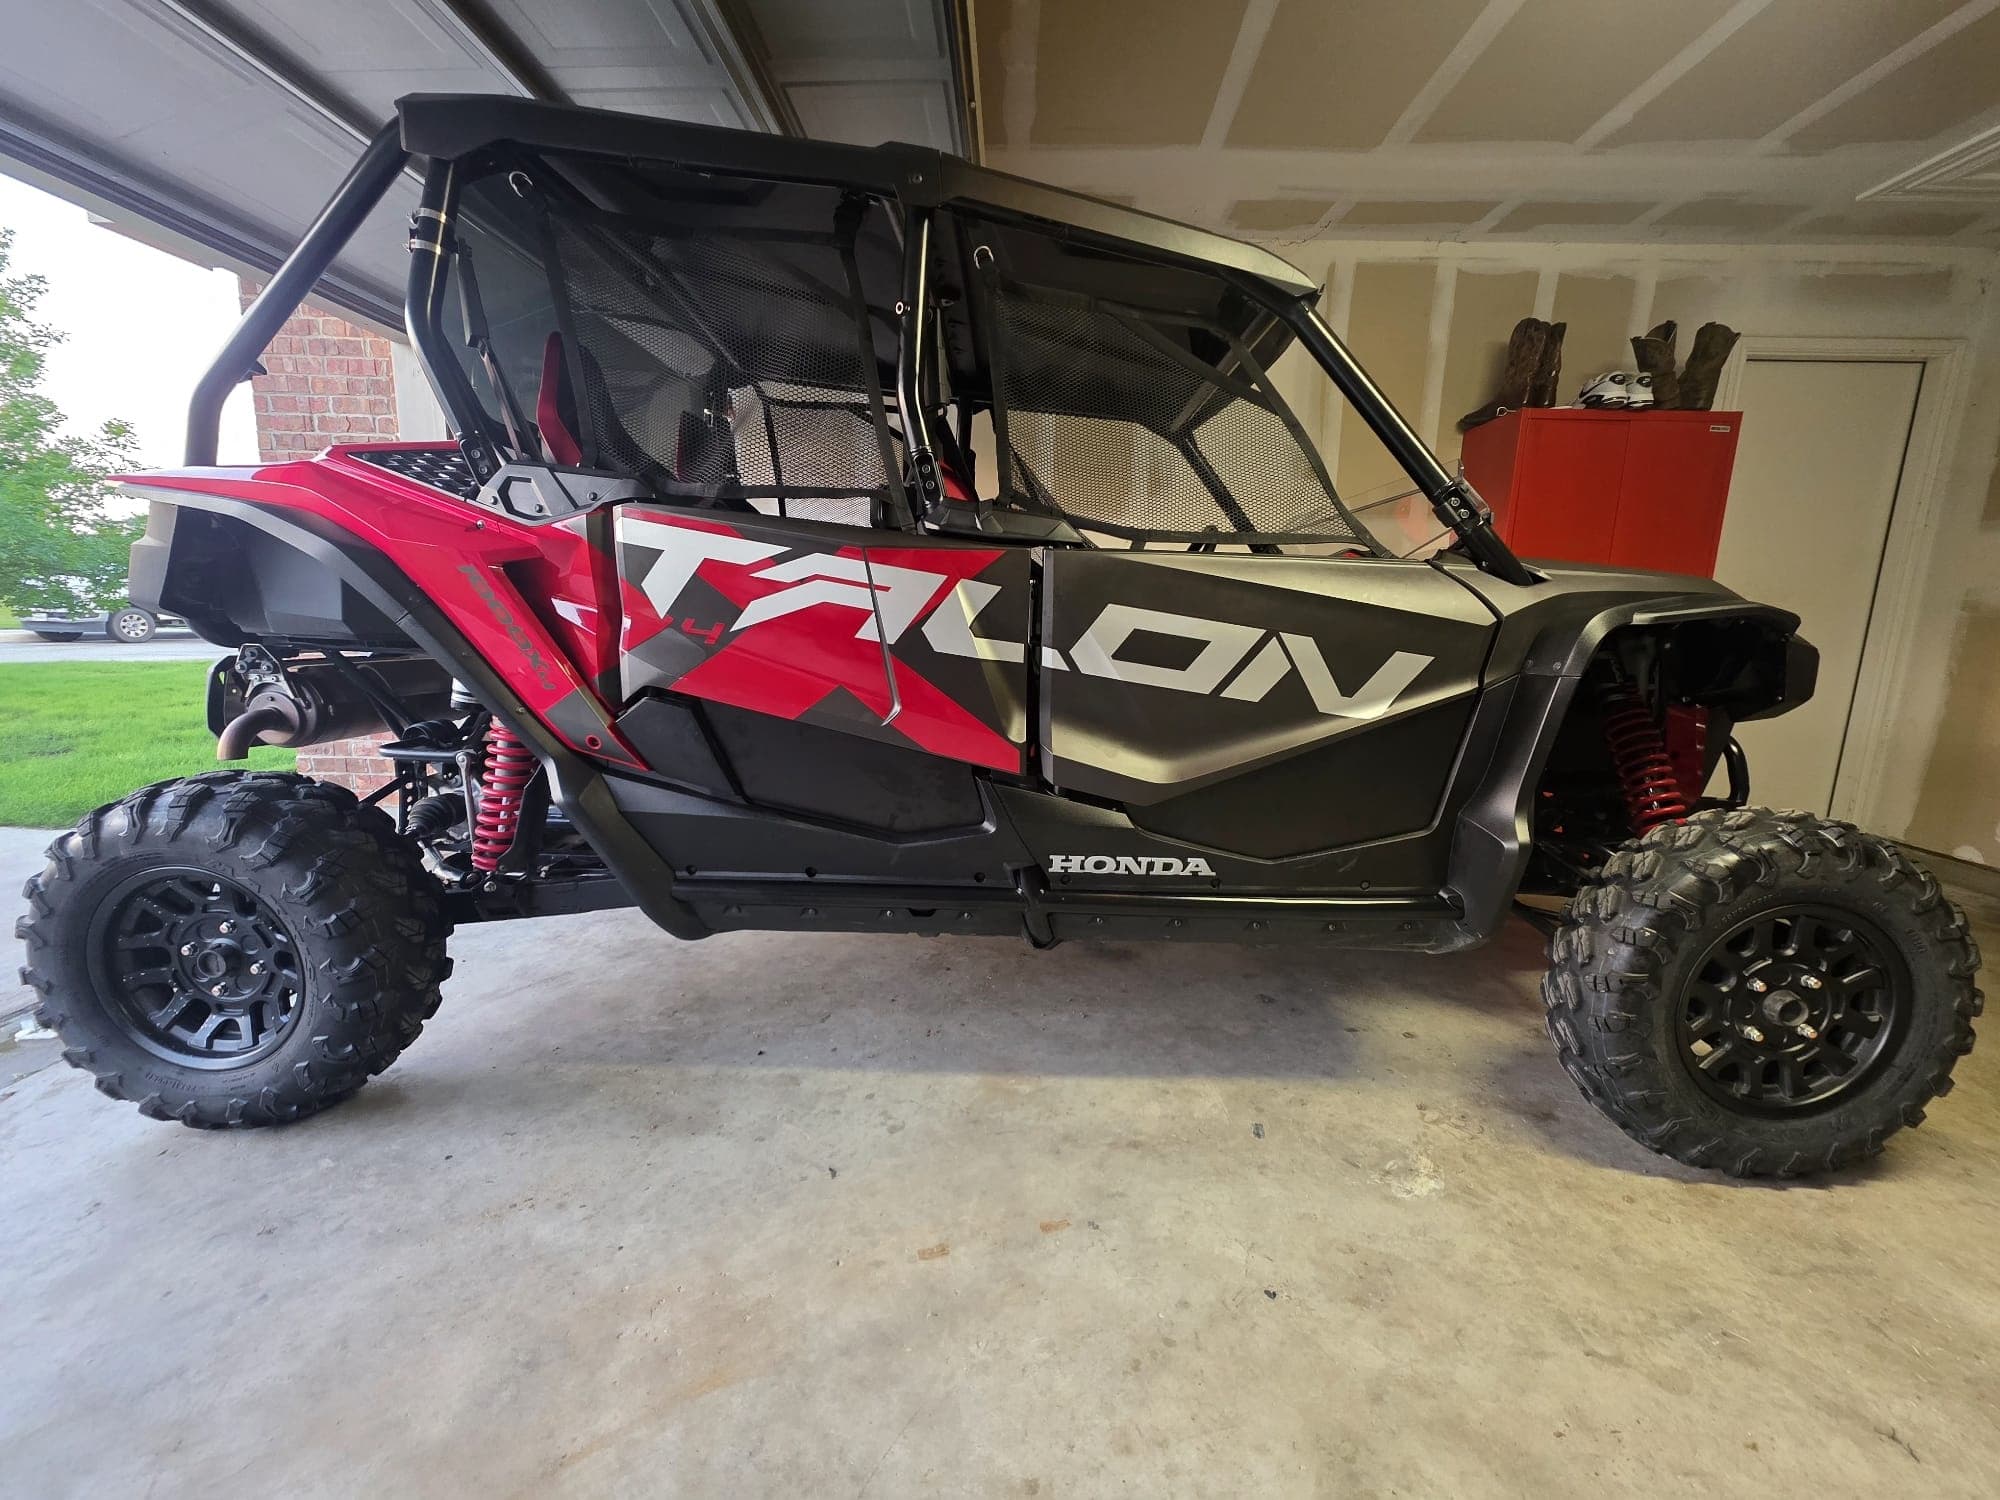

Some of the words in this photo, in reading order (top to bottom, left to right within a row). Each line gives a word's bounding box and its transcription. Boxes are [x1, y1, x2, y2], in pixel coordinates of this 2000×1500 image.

[616, 517, 1435, 720] TALON
[681, 617, 726, 645] 4
[1048, 854, 1217, 876] HONDA
